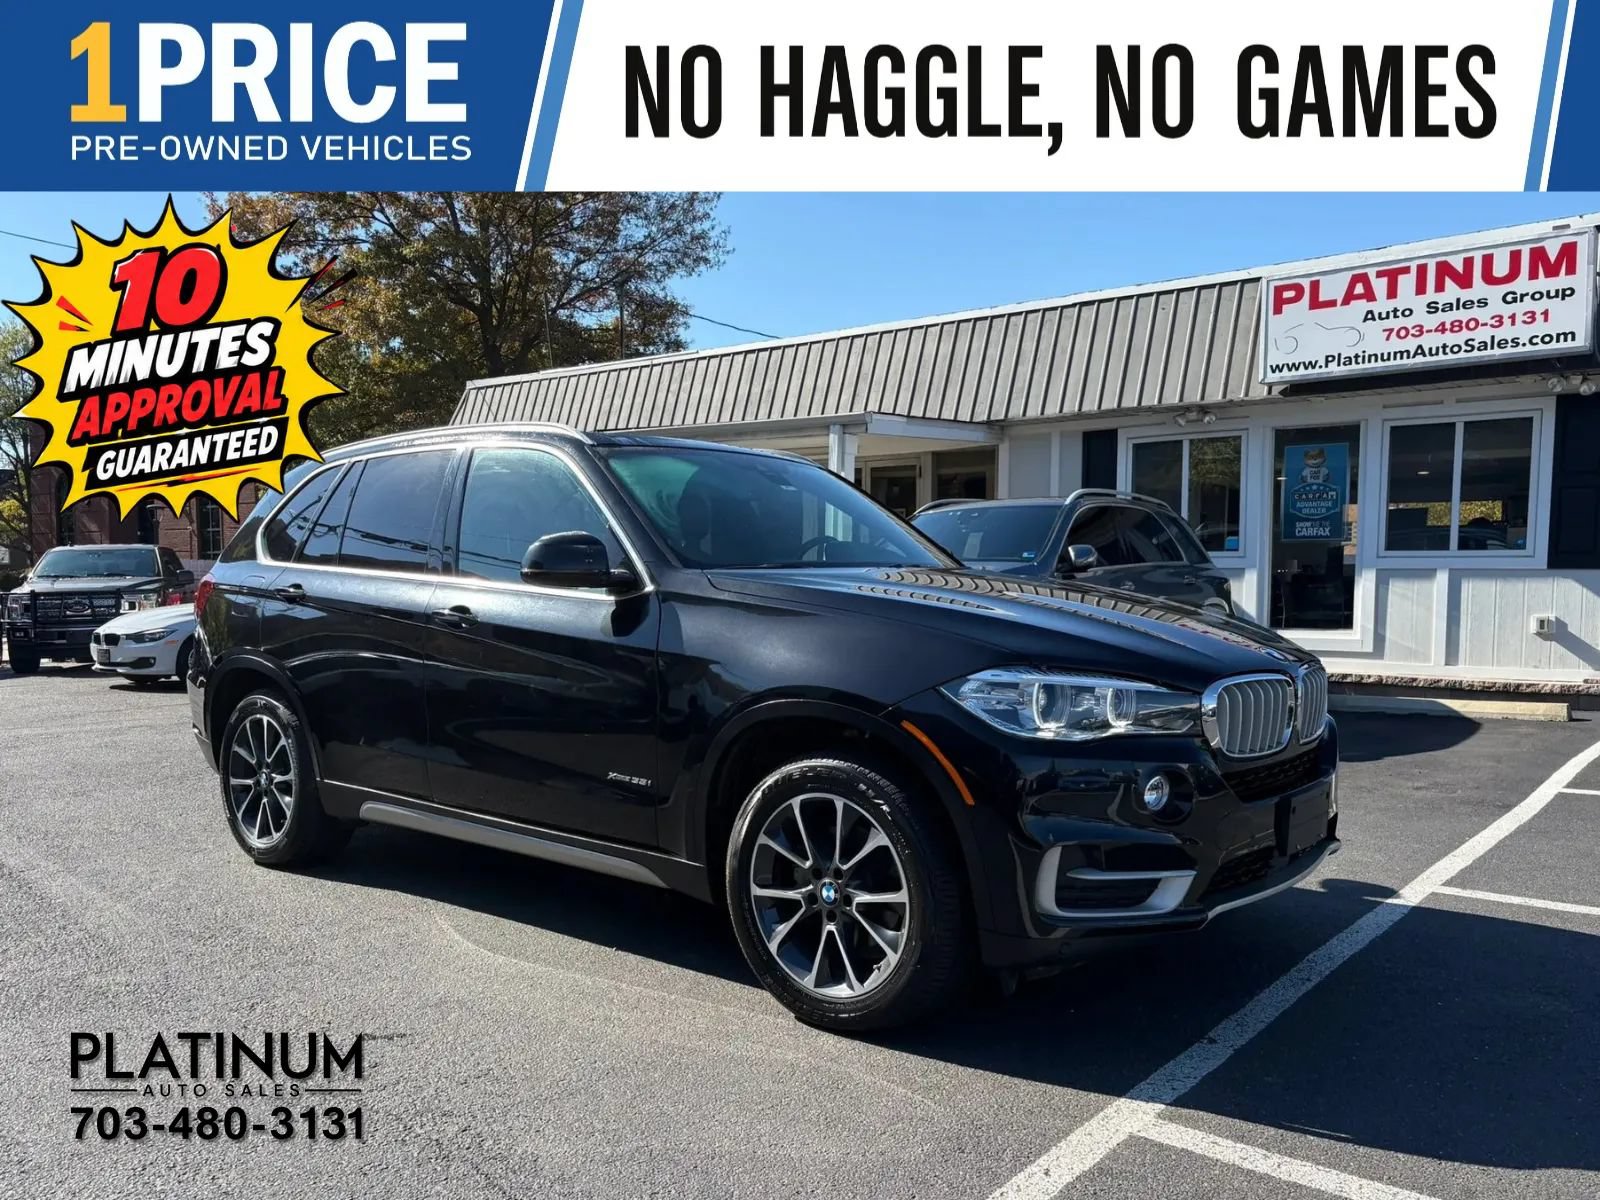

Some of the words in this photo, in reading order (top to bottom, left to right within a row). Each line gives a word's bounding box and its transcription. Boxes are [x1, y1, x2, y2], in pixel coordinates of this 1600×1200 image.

[1272, 240, 1578, 316] PLATINUM
[1362, 307, 1414, 323] Auto
[1426, 296, 1489, 315] Sales
[1501, 284, 1576, 305] Group
[1382, 308, 1552, 342] 703-480-3131
[1269, 330, 1577, 374] www.PlatinumAutoSales.com
[1296, 527, 1330, 536] CARFAX
